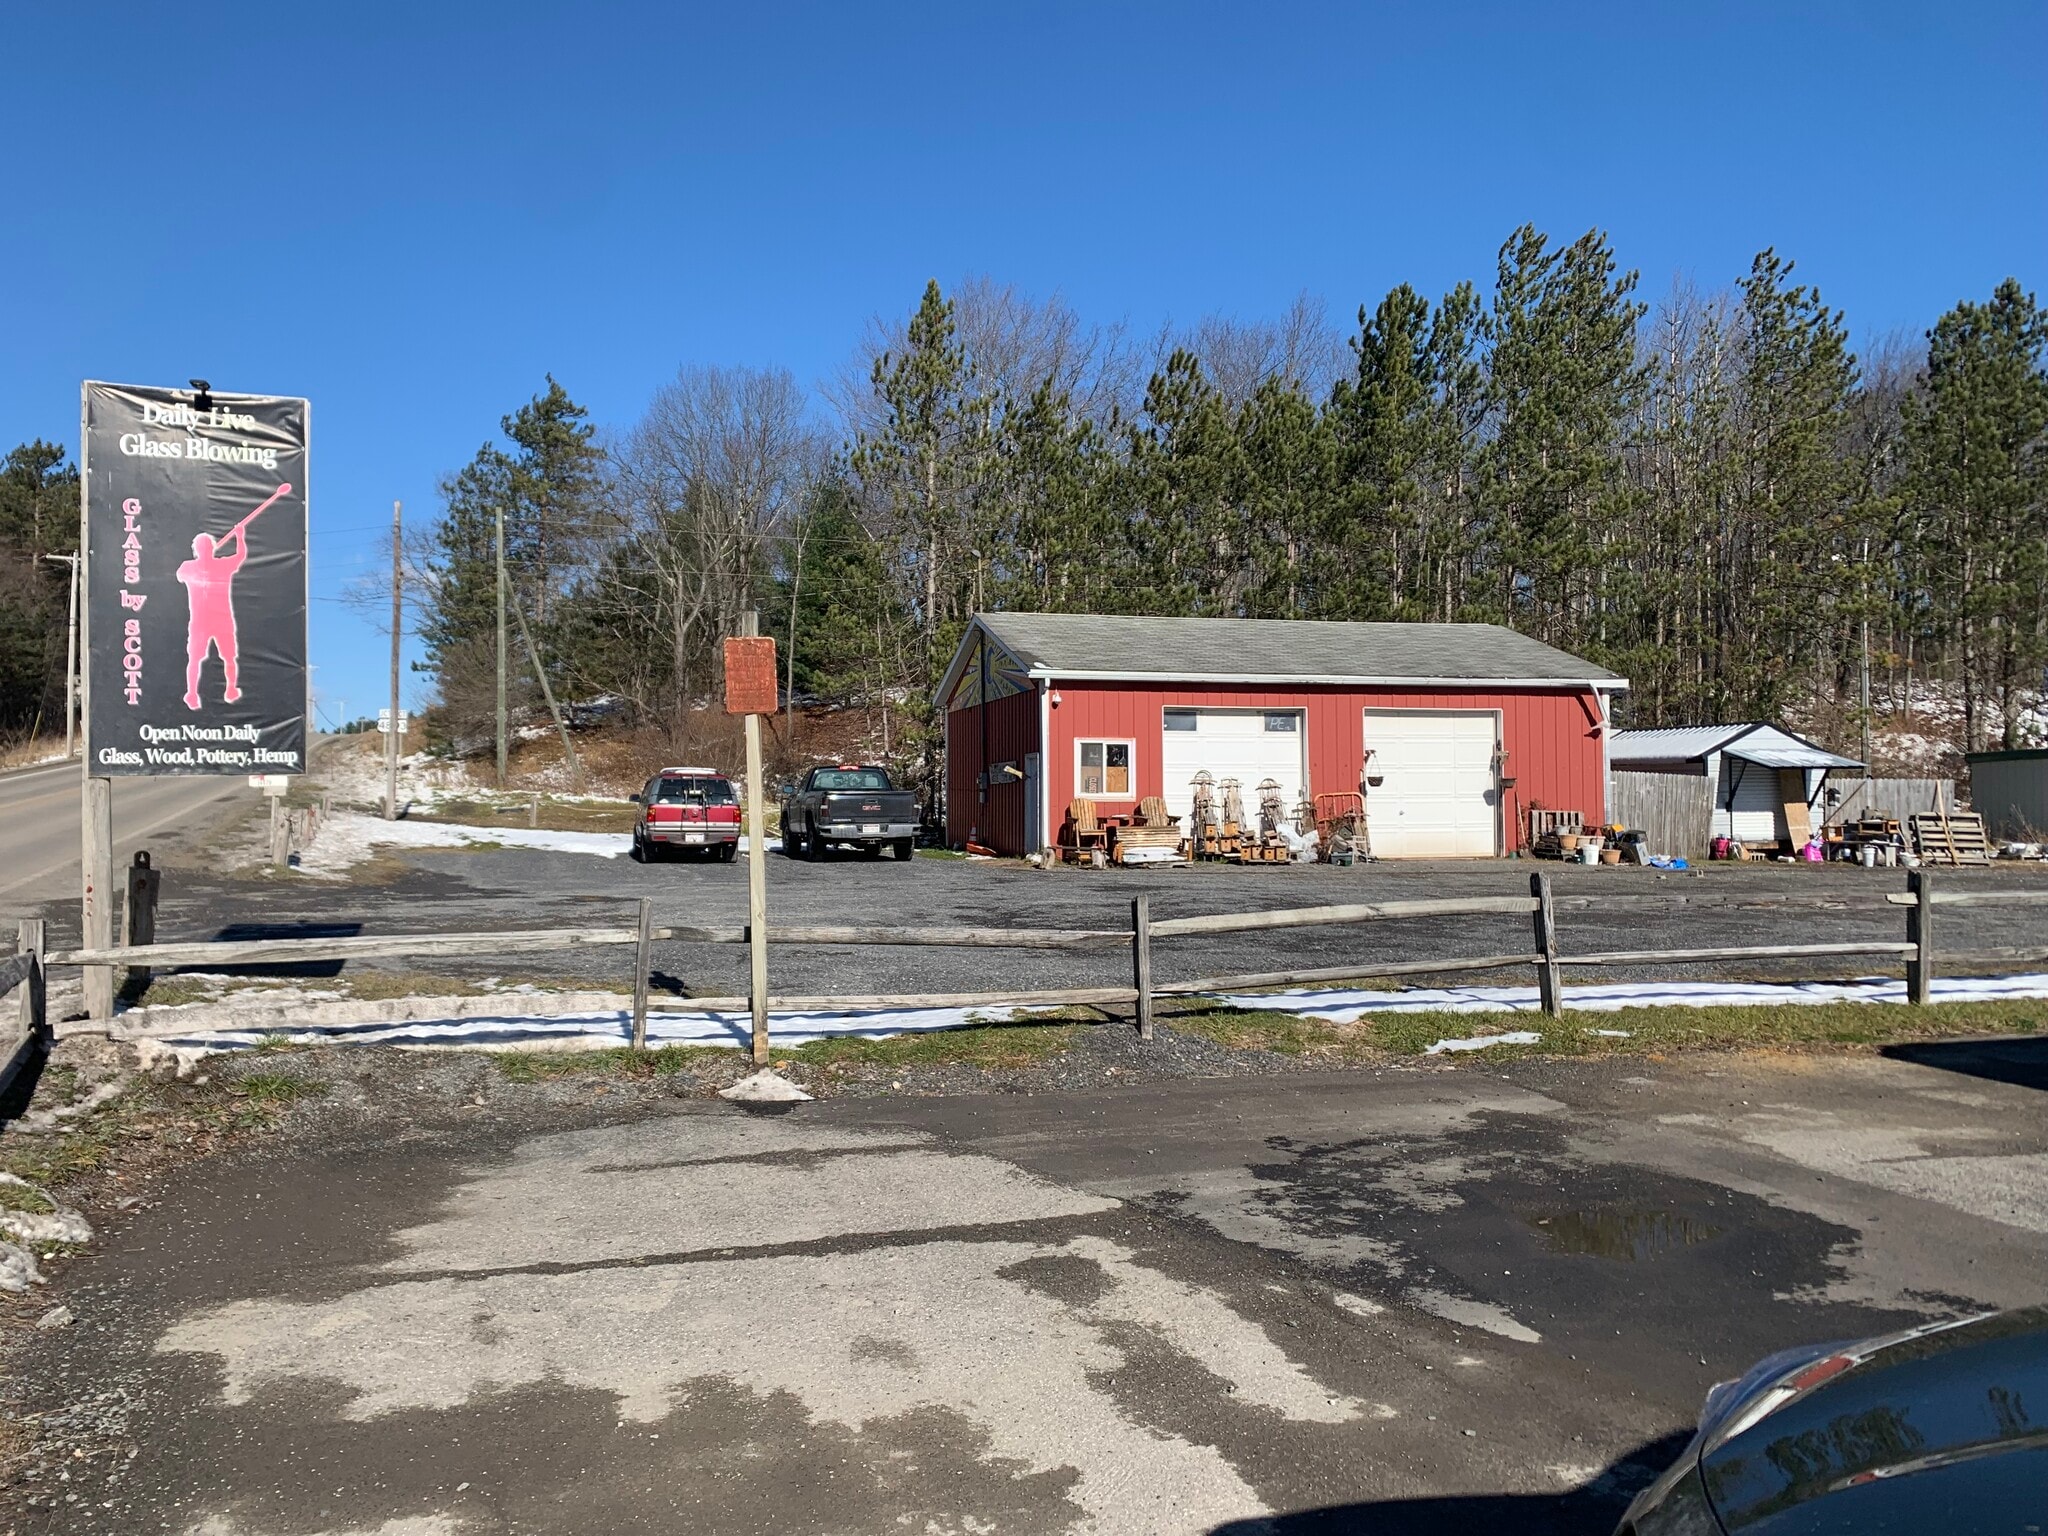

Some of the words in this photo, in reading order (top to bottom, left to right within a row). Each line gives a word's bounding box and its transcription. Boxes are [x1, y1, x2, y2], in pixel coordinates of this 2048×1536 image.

[142, 402, 200, 431] Daily
[208, 406, 256, 431] Live
[119, 433, 182, 458] Glass
[185, 437, 277, 470] Blowing
[122, 498, 143, 584] GLASS
[119, 589, 147, 611] by
[122, 619, 143, 705] SCOTT
[139, 724, 181, 744] Open
[181, 724, 224, 741] Noon
[224, 724, 261, 744] Daily
[99, 748, 144, 766] Glass,
[145, 748, 195, 766] Wood,
[196, 748, 251, 767] Pottery,
[253, 749, 299, 767] Hemp
